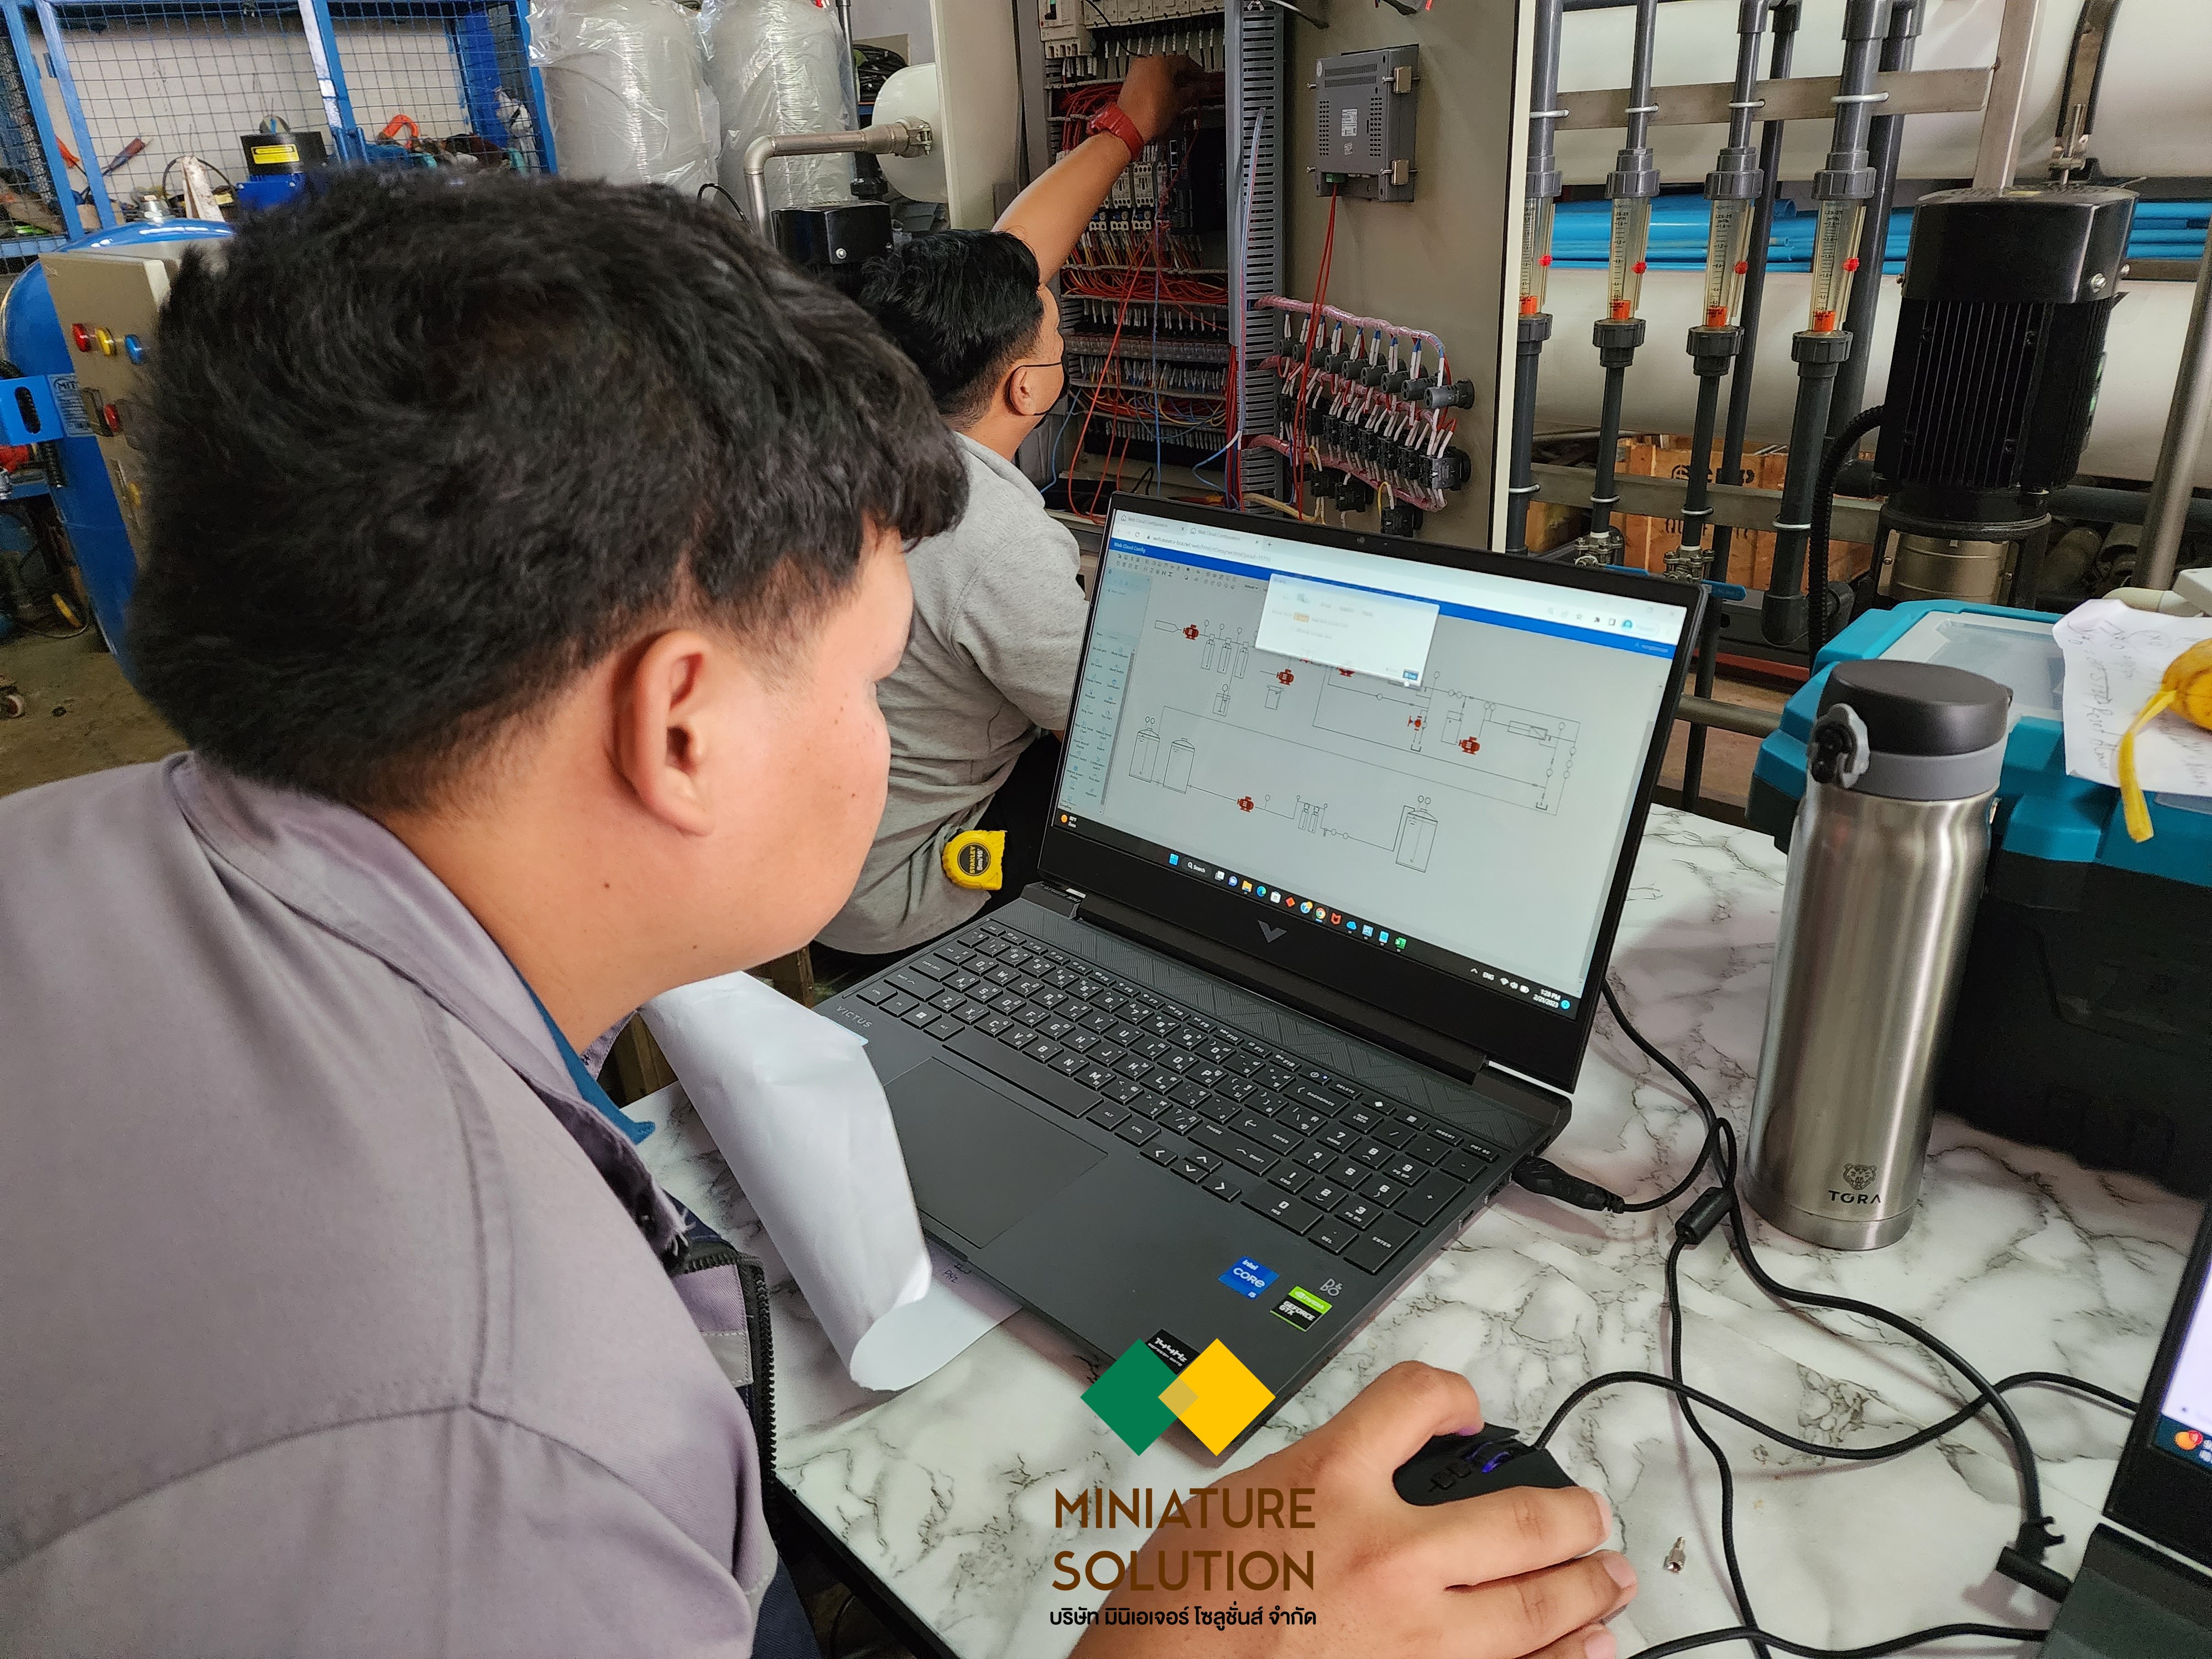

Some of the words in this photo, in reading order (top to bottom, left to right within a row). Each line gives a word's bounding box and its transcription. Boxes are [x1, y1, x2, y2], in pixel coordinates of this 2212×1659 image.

[1193, 864, 1206, 873] Search
[1483, 972, 1494, 980] ENG
[836, 1005, 873, 1028] VICTUS
[1335, 1083, 1355, 1094] DELETE
[1306, 1091, 1335, 1108] BACKSPACE
[1828, 1190, 1881, 1204] TORA
[1279, 1305, 1296, 1316] GTX
[1284, 1301, 1315, 1321] GEFORCE
[1155, 1337, 1187, 1362] 144Hz
